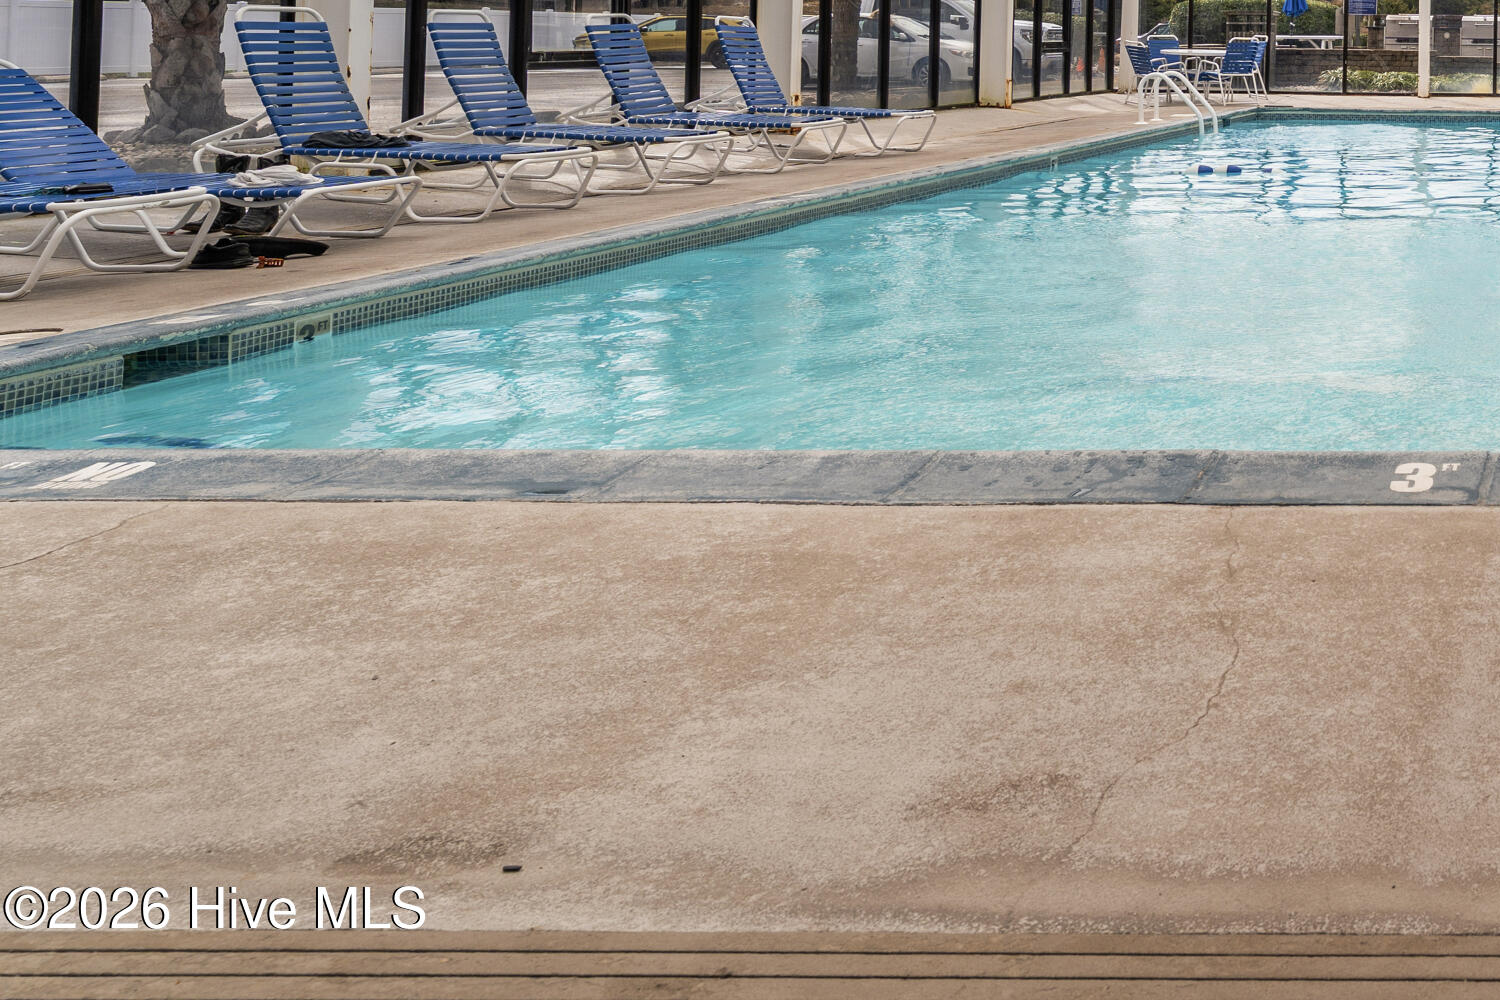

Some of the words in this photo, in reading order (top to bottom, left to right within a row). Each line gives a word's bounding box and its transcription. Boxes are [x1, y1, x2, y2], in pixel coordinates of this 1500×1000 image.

[318, 320, 328, 331] FT
[1390, 462, 1437, 493] 3
[1442, 463, 1461, 472] FT
